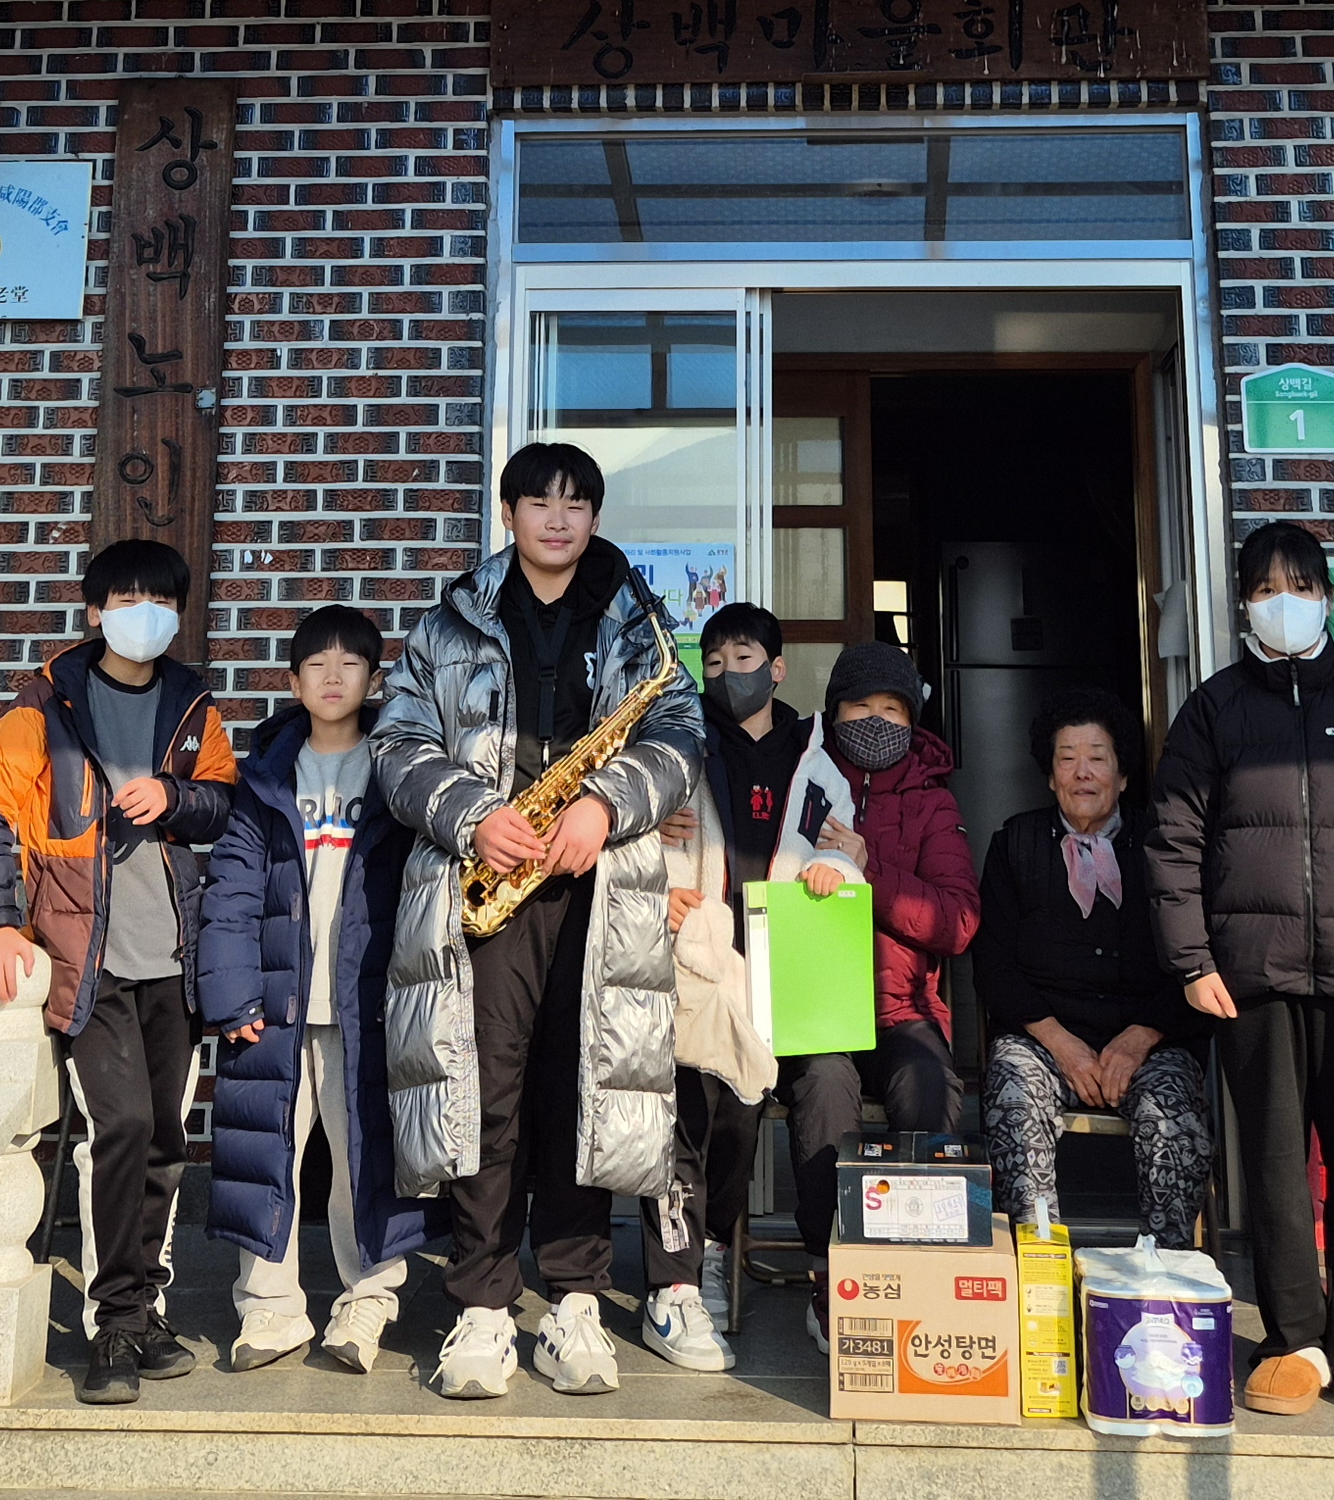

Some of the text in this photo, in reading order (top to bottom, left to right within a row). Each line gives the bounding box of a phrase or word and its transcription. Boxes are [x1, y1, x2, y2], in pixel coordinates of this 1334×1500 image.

[1278, 377, 1312, 391] 상백길
[1289, 409, 1306, 441] 1
[862, 1282, 901, 1300] 농심
[958, 1279, 1003, 1298] 멀티팩
[841, 1339, 890, 1354] 가3481
[910, 1333, 997, 1360] 안성탕면
